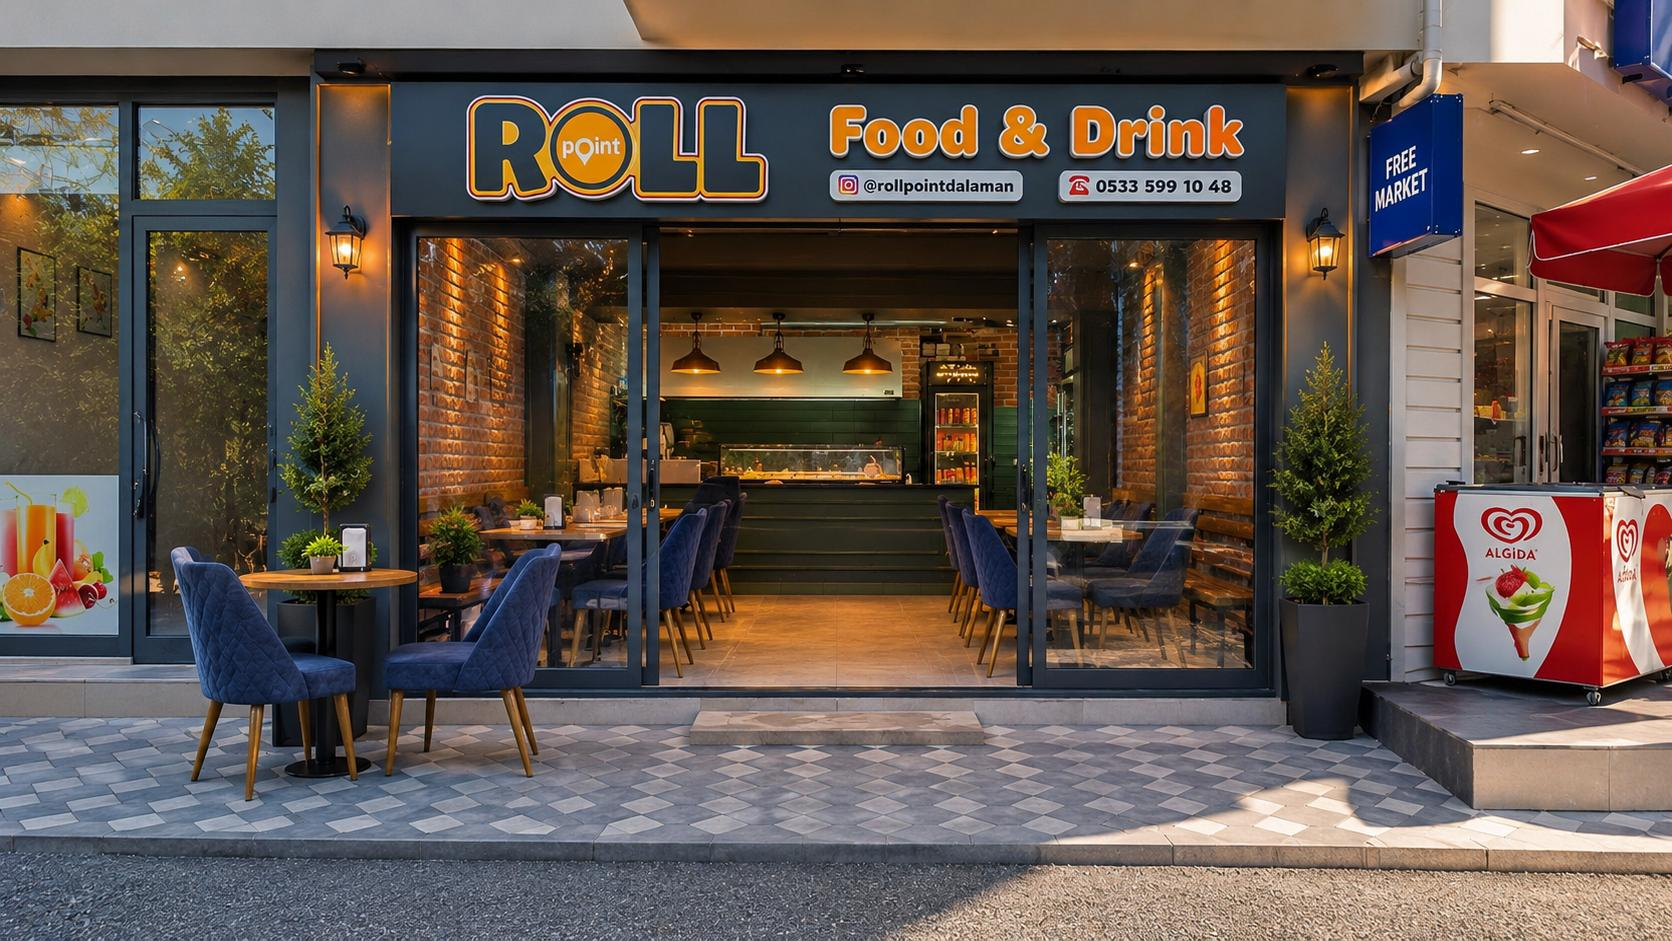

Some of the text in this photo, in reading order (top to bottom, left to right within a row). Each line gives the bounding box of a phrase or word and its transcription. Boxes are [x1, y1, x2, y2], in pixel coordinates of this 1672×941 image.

[467, 96, 769, 200] ROLL
[830, 104, 1244, 158] Food & Drink
[562, 137, 620, 165] point
[1386, 145, 1417, 180] FREE
[863, 179, 1014, 195] @rollpointdalaman
[1095, 179, 1232, 194] 0533 599 10 48
[1375, 168, 1428, 212] MARKET
